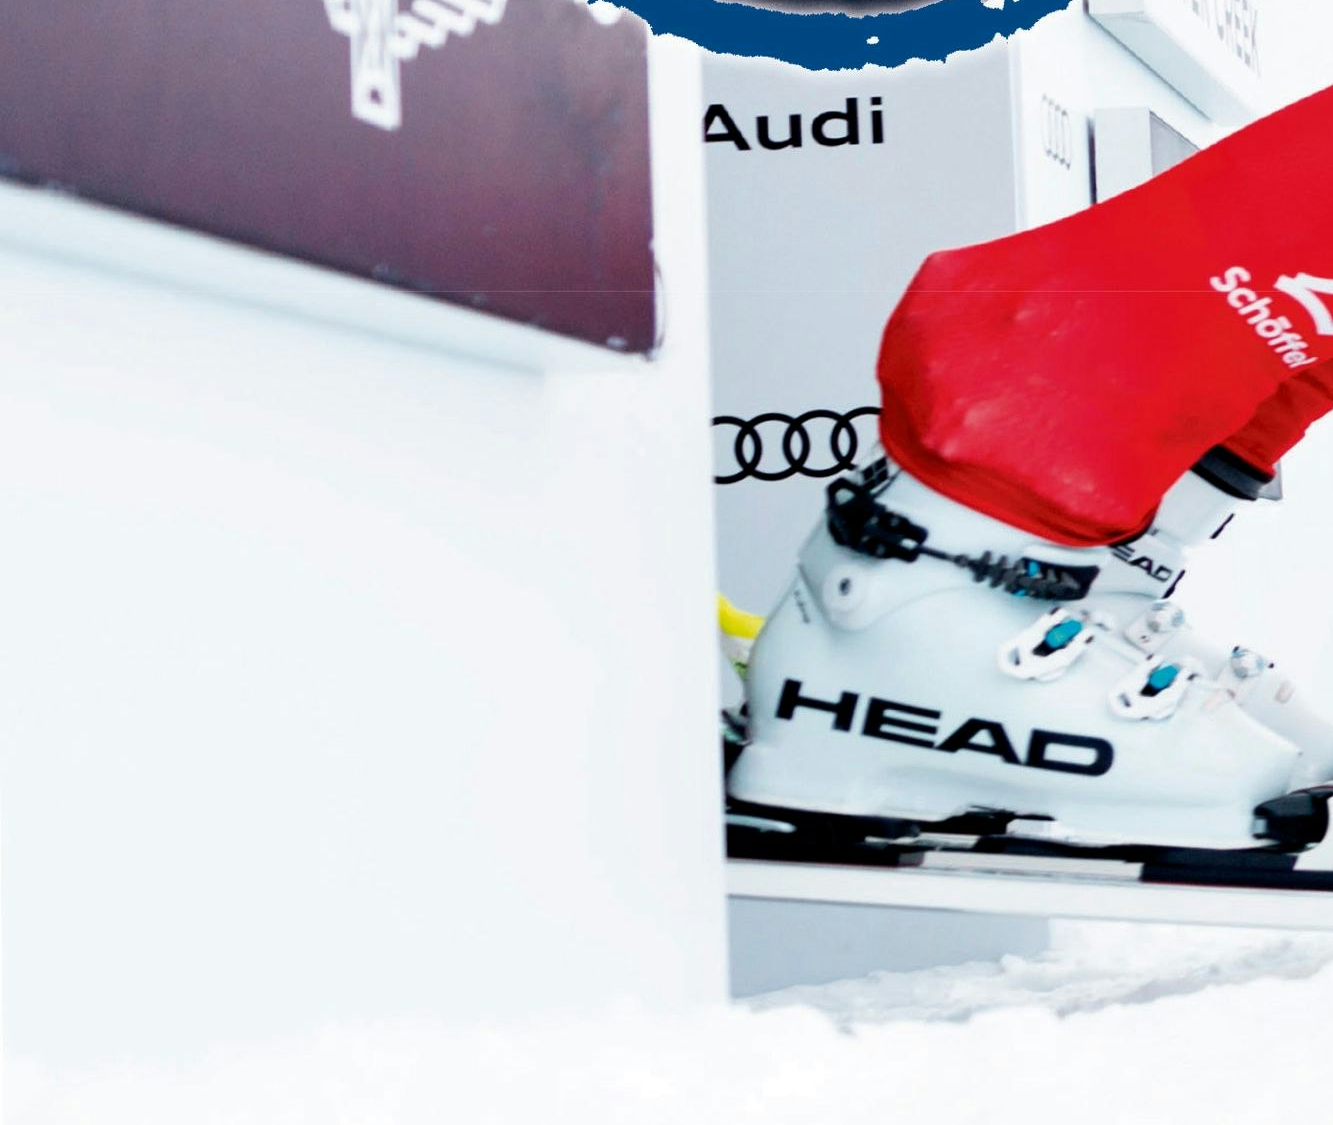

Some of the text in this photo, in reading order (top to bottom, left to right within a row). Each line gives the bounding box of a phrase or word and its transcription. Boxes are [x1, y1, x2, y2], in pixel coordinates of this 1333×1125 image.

[702, 97, 886, 151] Audi
[1110, 543, 1174, 584] EAD
[774, 678, 1115, 778] HEAD
